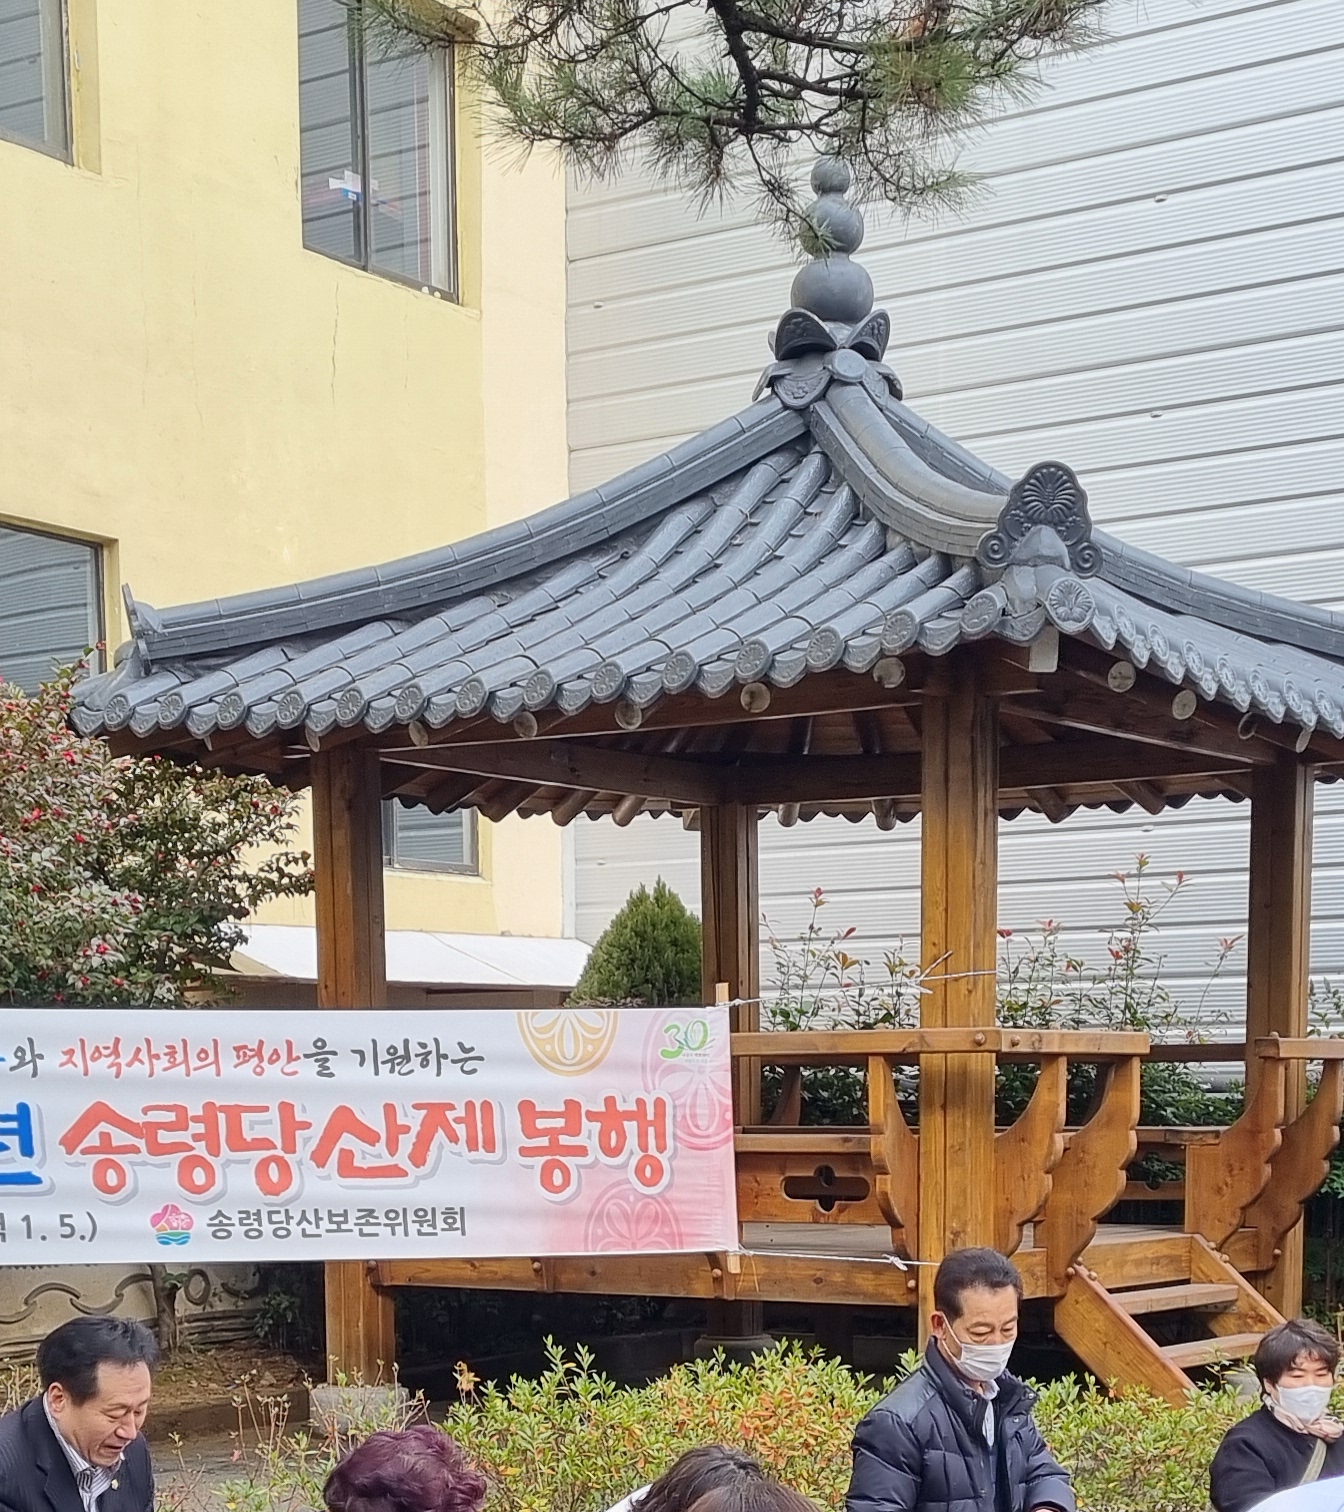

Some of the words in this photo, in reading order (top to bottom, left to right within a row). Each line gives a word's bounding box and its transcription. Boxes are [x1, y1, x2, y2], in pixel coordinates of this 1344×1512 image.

[58, 1037, 222, 1078] 지역사회의
[232, 1037, 338, 1078] 평안을
[354, 1037, 485, 1077] 기원하는
[660, 1020, 709, 1059] 30
[58, 1099, 497, 1197] 송령당산제
[517, 1098, 669, 1193] 봉행
[59, 1211, 99, 1243] 5.)
[206, 1206, 467, 1240] 송령당산보존위원회
